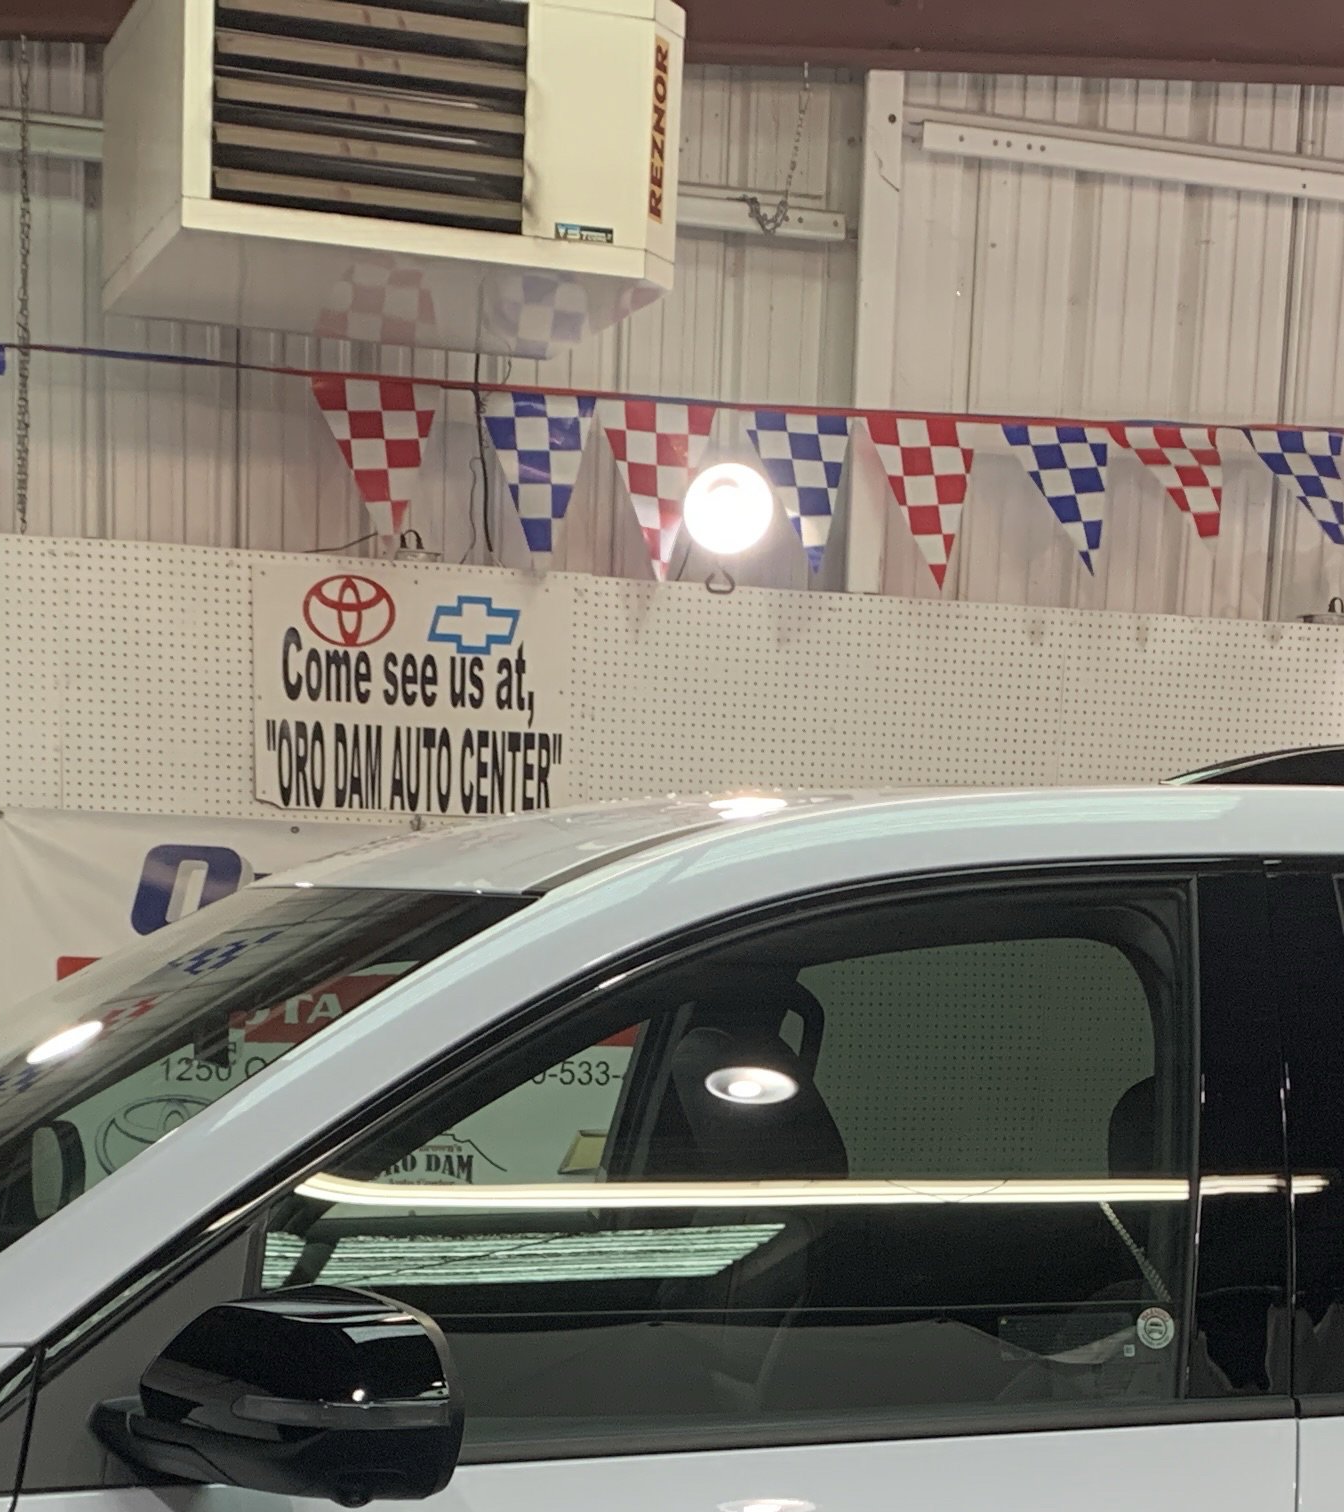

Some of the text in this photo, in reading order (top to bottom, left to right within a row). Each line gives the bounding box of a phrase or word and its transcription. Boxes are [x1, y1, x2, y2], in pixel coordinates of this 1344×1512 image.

[648, 44, 669, 219] REZNOR
[282, 626, 535, 729] Come see us at,
[334, 722, 383, 810] DAM
[389, 726, 452, 813] AUTO
[531, 1060, 624, 1086] -533-
[426, 1154, 474, 1185] DAM
